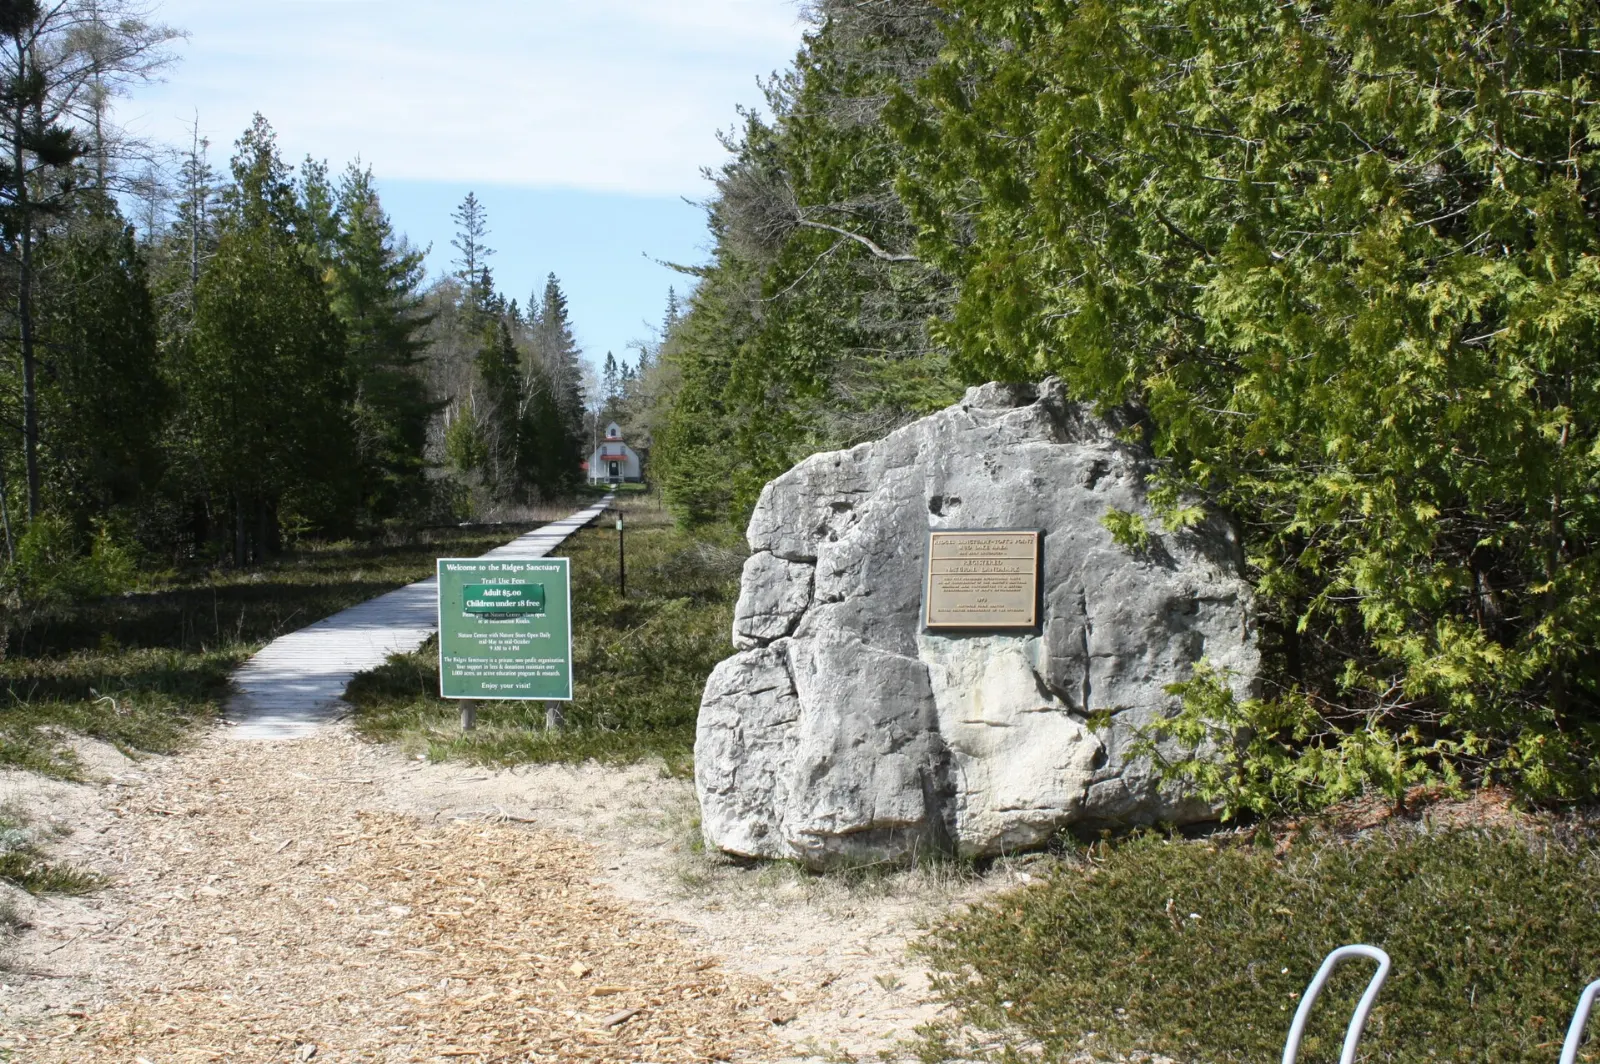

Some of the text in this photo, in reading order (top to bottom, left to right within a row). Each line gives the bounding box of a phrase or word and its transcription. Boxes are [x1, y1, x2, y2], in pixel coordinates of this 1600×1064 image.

[502, 564, 523, 572] Ridges
[526, 564, 560, 572] Sanctuary
[502, 589, 521, 598] $5.00
